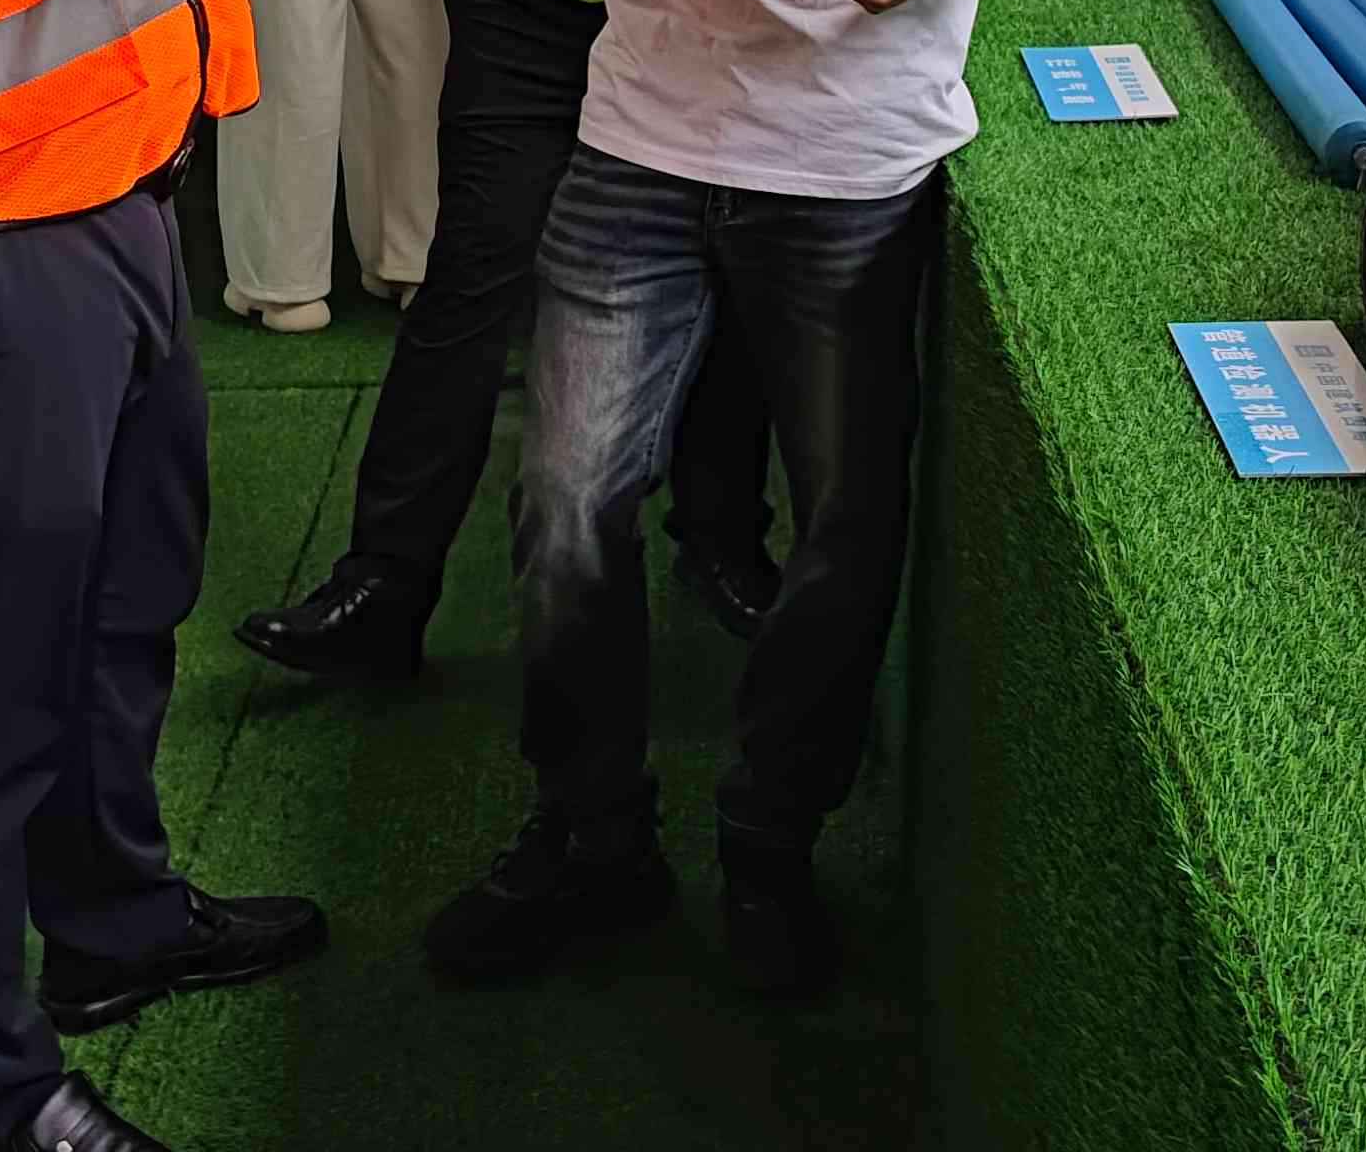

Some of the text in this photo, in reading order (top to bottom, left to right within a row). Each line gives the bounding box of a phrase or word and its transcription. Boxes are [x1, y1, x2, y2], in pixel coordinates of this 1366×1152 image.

[1200, 329, 1308, 463] 管道检测机器人
